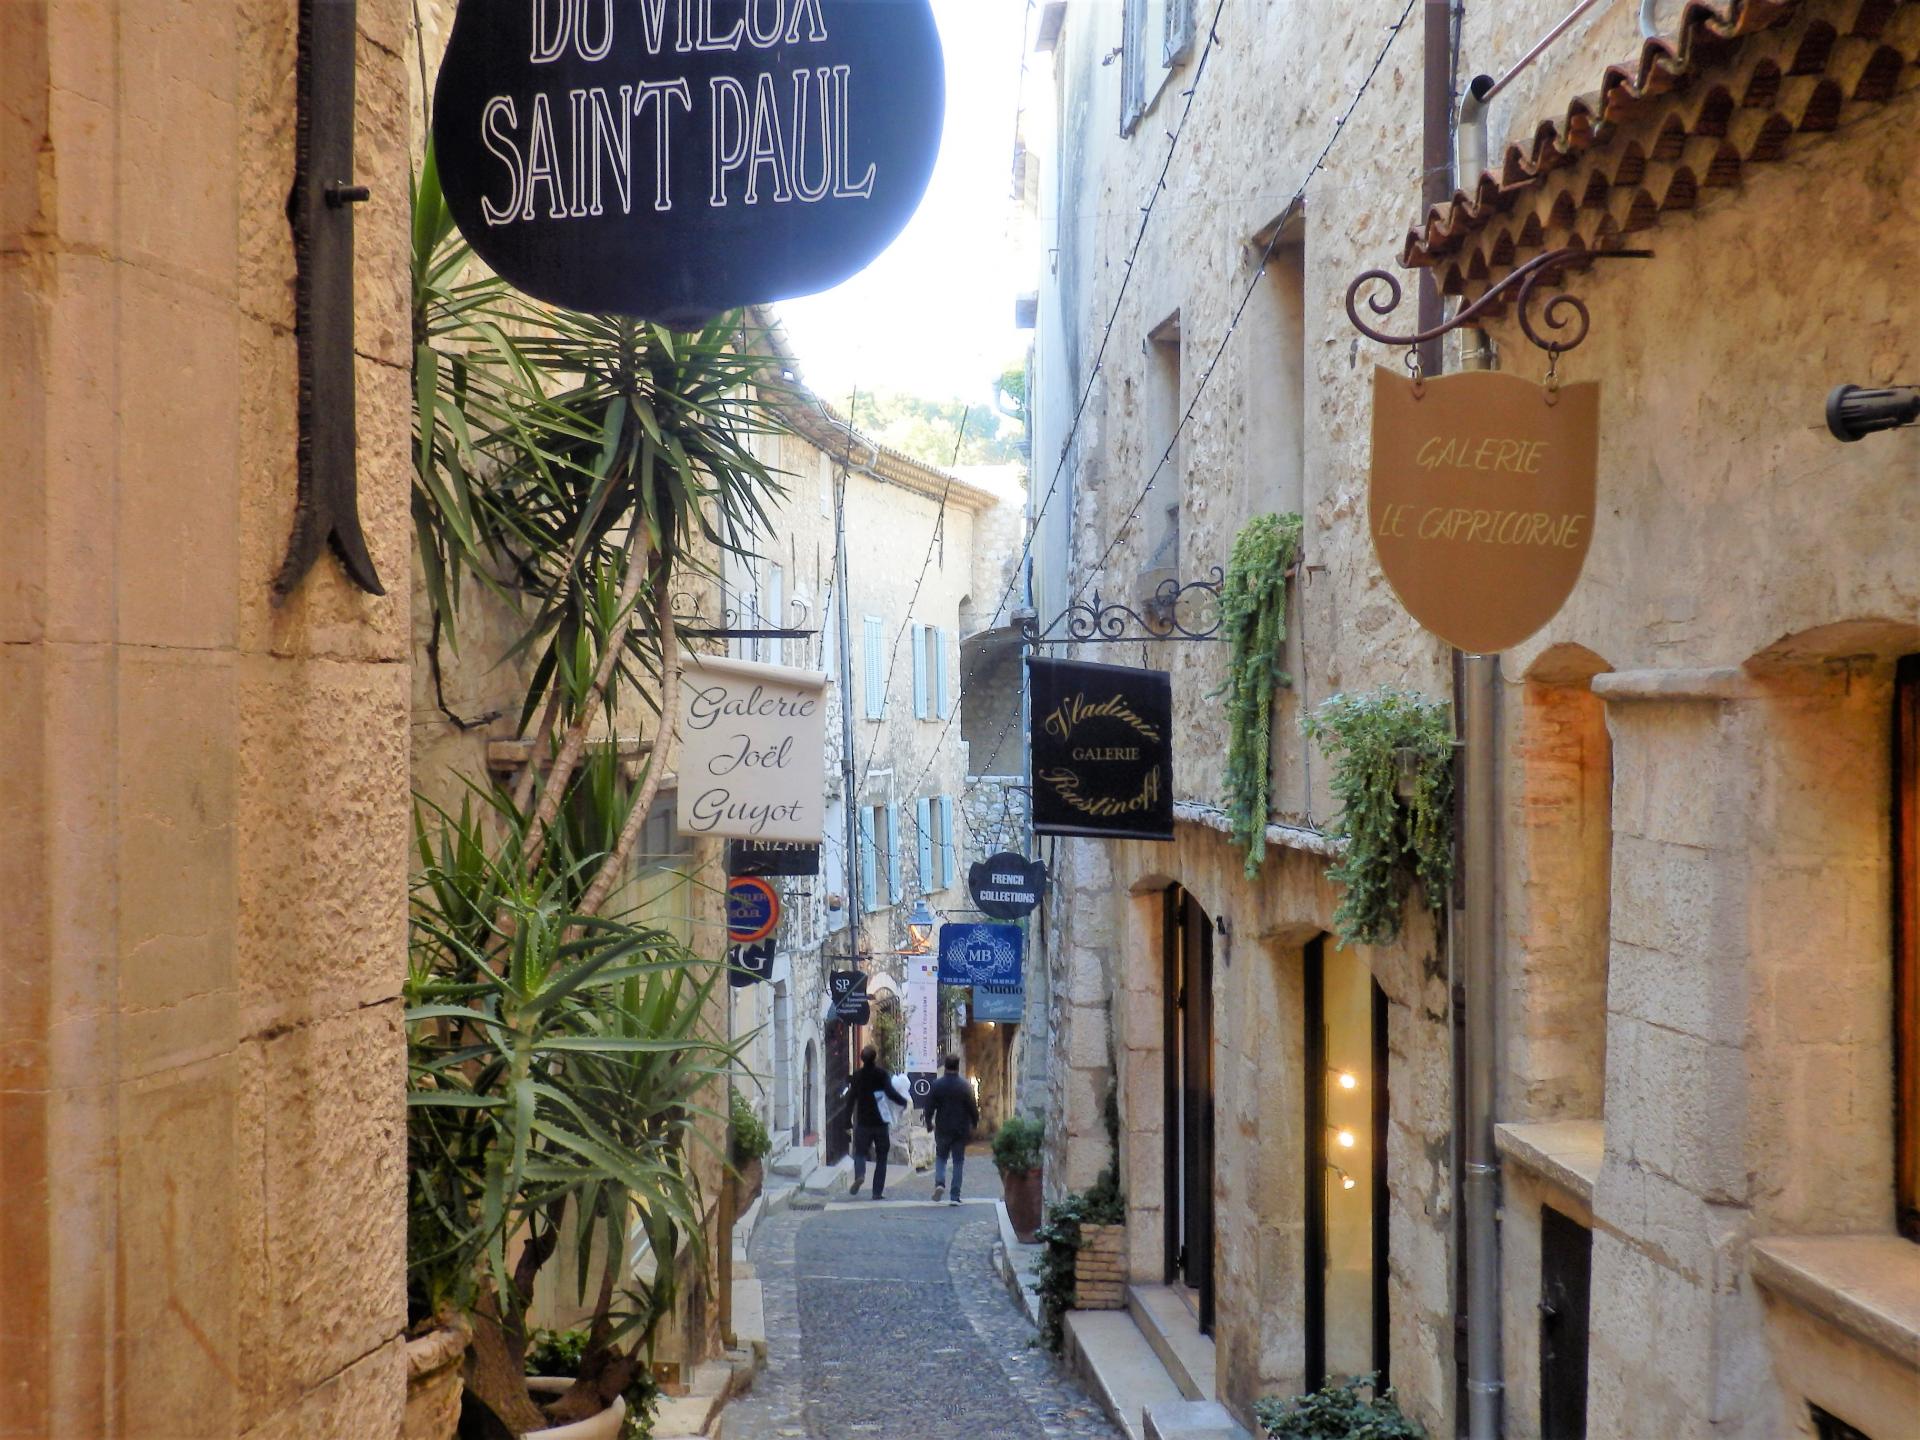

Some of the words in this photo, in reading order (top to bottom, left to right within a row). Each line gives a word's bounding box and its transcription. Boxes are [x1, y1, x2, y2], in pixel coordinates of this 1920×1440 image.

[481, 77, 692, 227] SAINT
[710, 65, 877, 206] PAUL
[1416, 436, 1550, 474] GALERIE
[1378, 503, 1415, 538] LE
[1417, 507, 1588, 549] CAPRICORNE
[687, 685, 817, 730] Galerie
[1045, 692, 1161, 743] Vladimir
[708, 734, 794, 776] Joël
[1072, 747, 1141, 761] GALERIE
[688, 788, 804, 835] Guyot
[980, 890, 1035, 903] COLLECTIONS
[991, 873, 1025, 885] FRENCH
[968, 949, 992, 962] MB
[835, 979, 850, 992] SP
